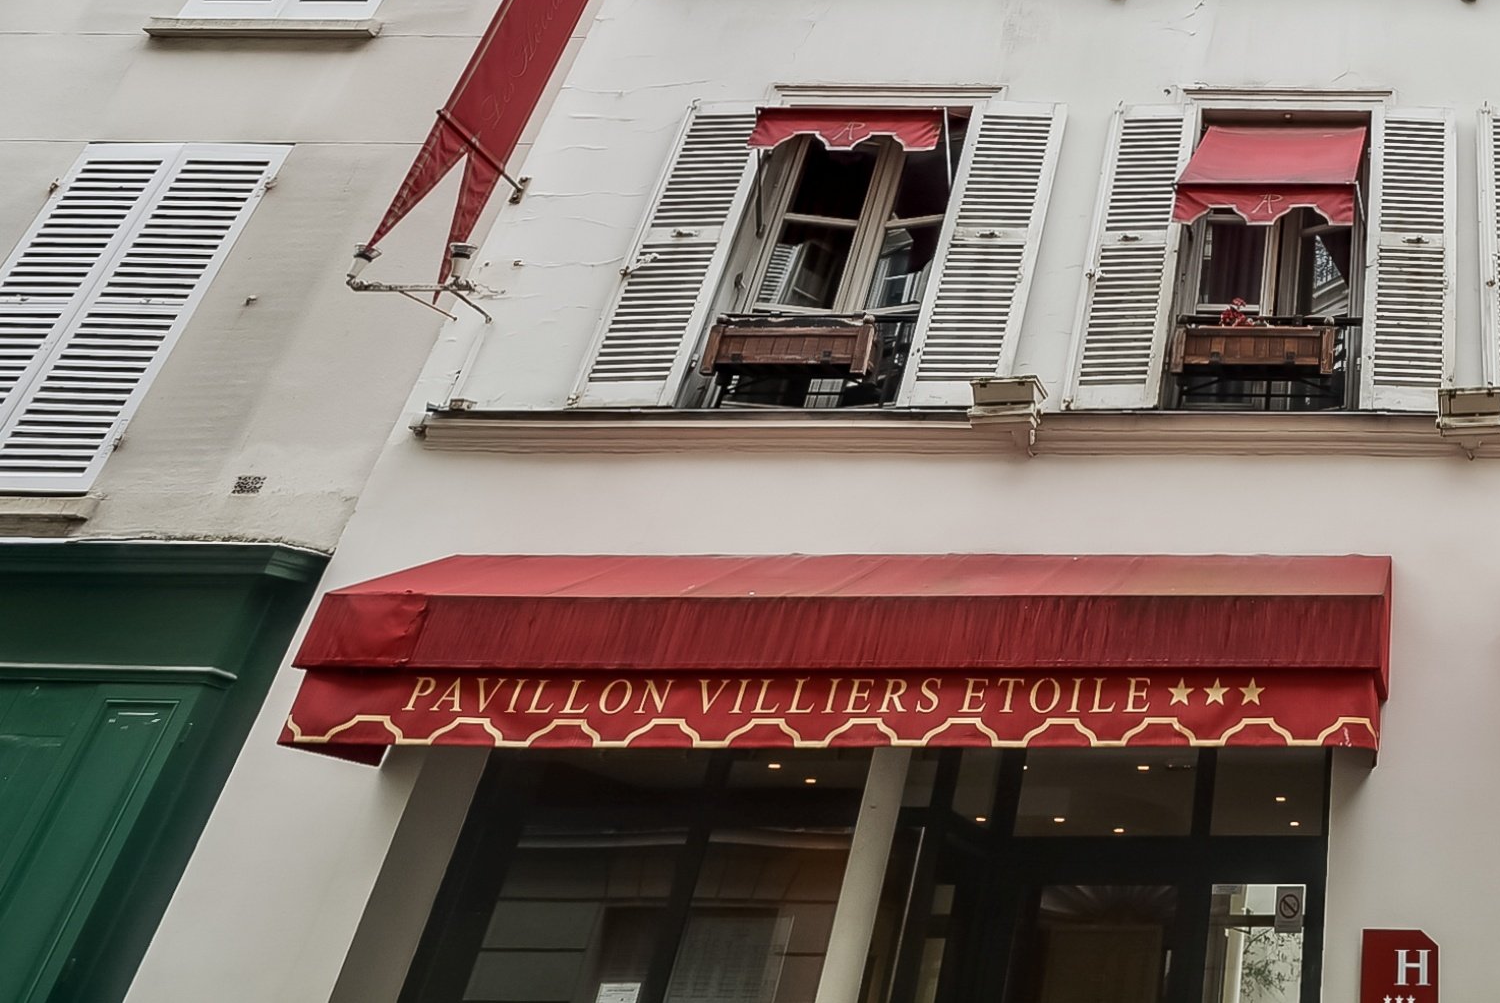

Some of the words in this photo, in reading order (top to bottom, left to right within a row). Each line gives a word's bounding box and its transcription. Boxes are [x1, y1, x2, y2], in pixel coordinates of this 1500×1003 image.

[401, 676, 676, 715] PAVILLON
[697, 676, 944, 715] VILLIERS
[957, 676, 1152, 714] ETOILE
[1393, 949, 1433, 987] H
